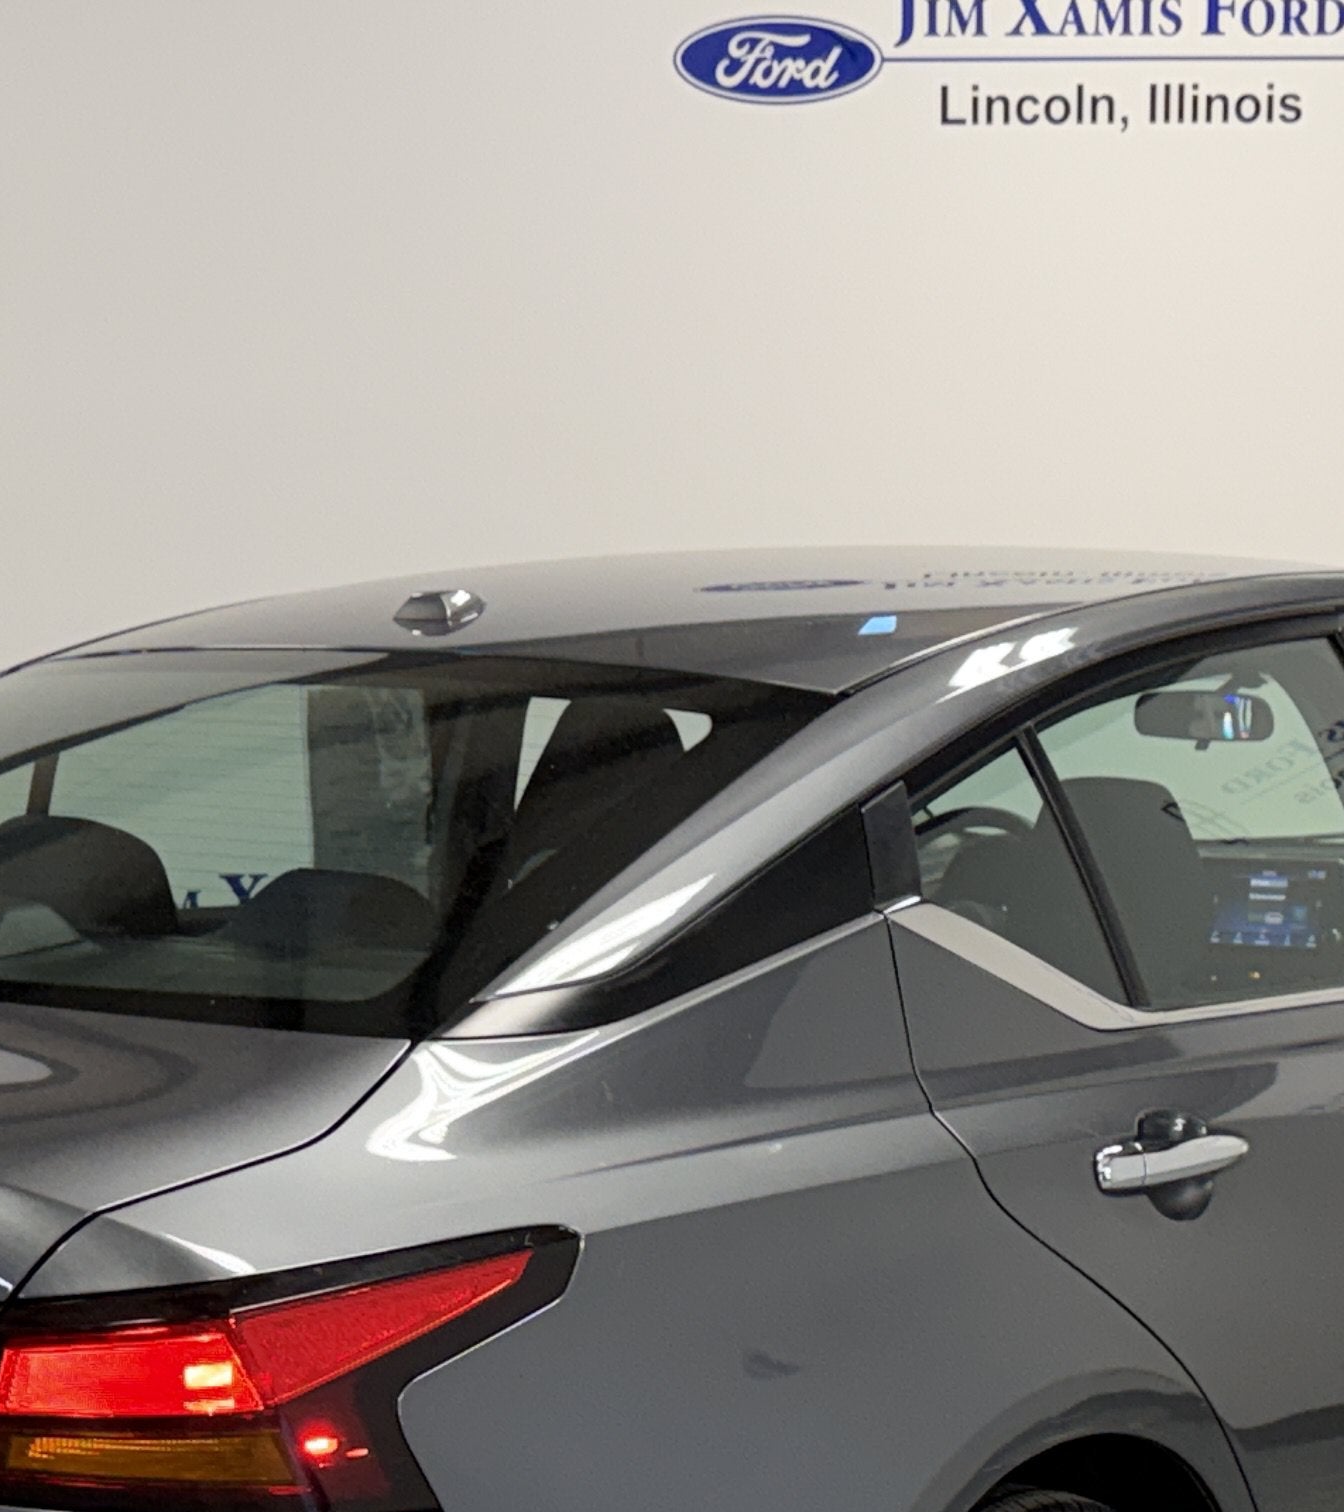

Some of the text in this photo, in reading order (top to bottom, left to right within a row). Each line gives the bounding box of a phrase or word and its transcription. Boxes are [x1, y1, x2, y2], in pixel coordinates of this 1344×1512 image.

[893, 0, 988, 48] JIM
[1005, 0, 1183, 37] XAMIS
[714, 30, 843, 89] Ford
[940, 83, 1303, 133] Lincoln, Illinois
